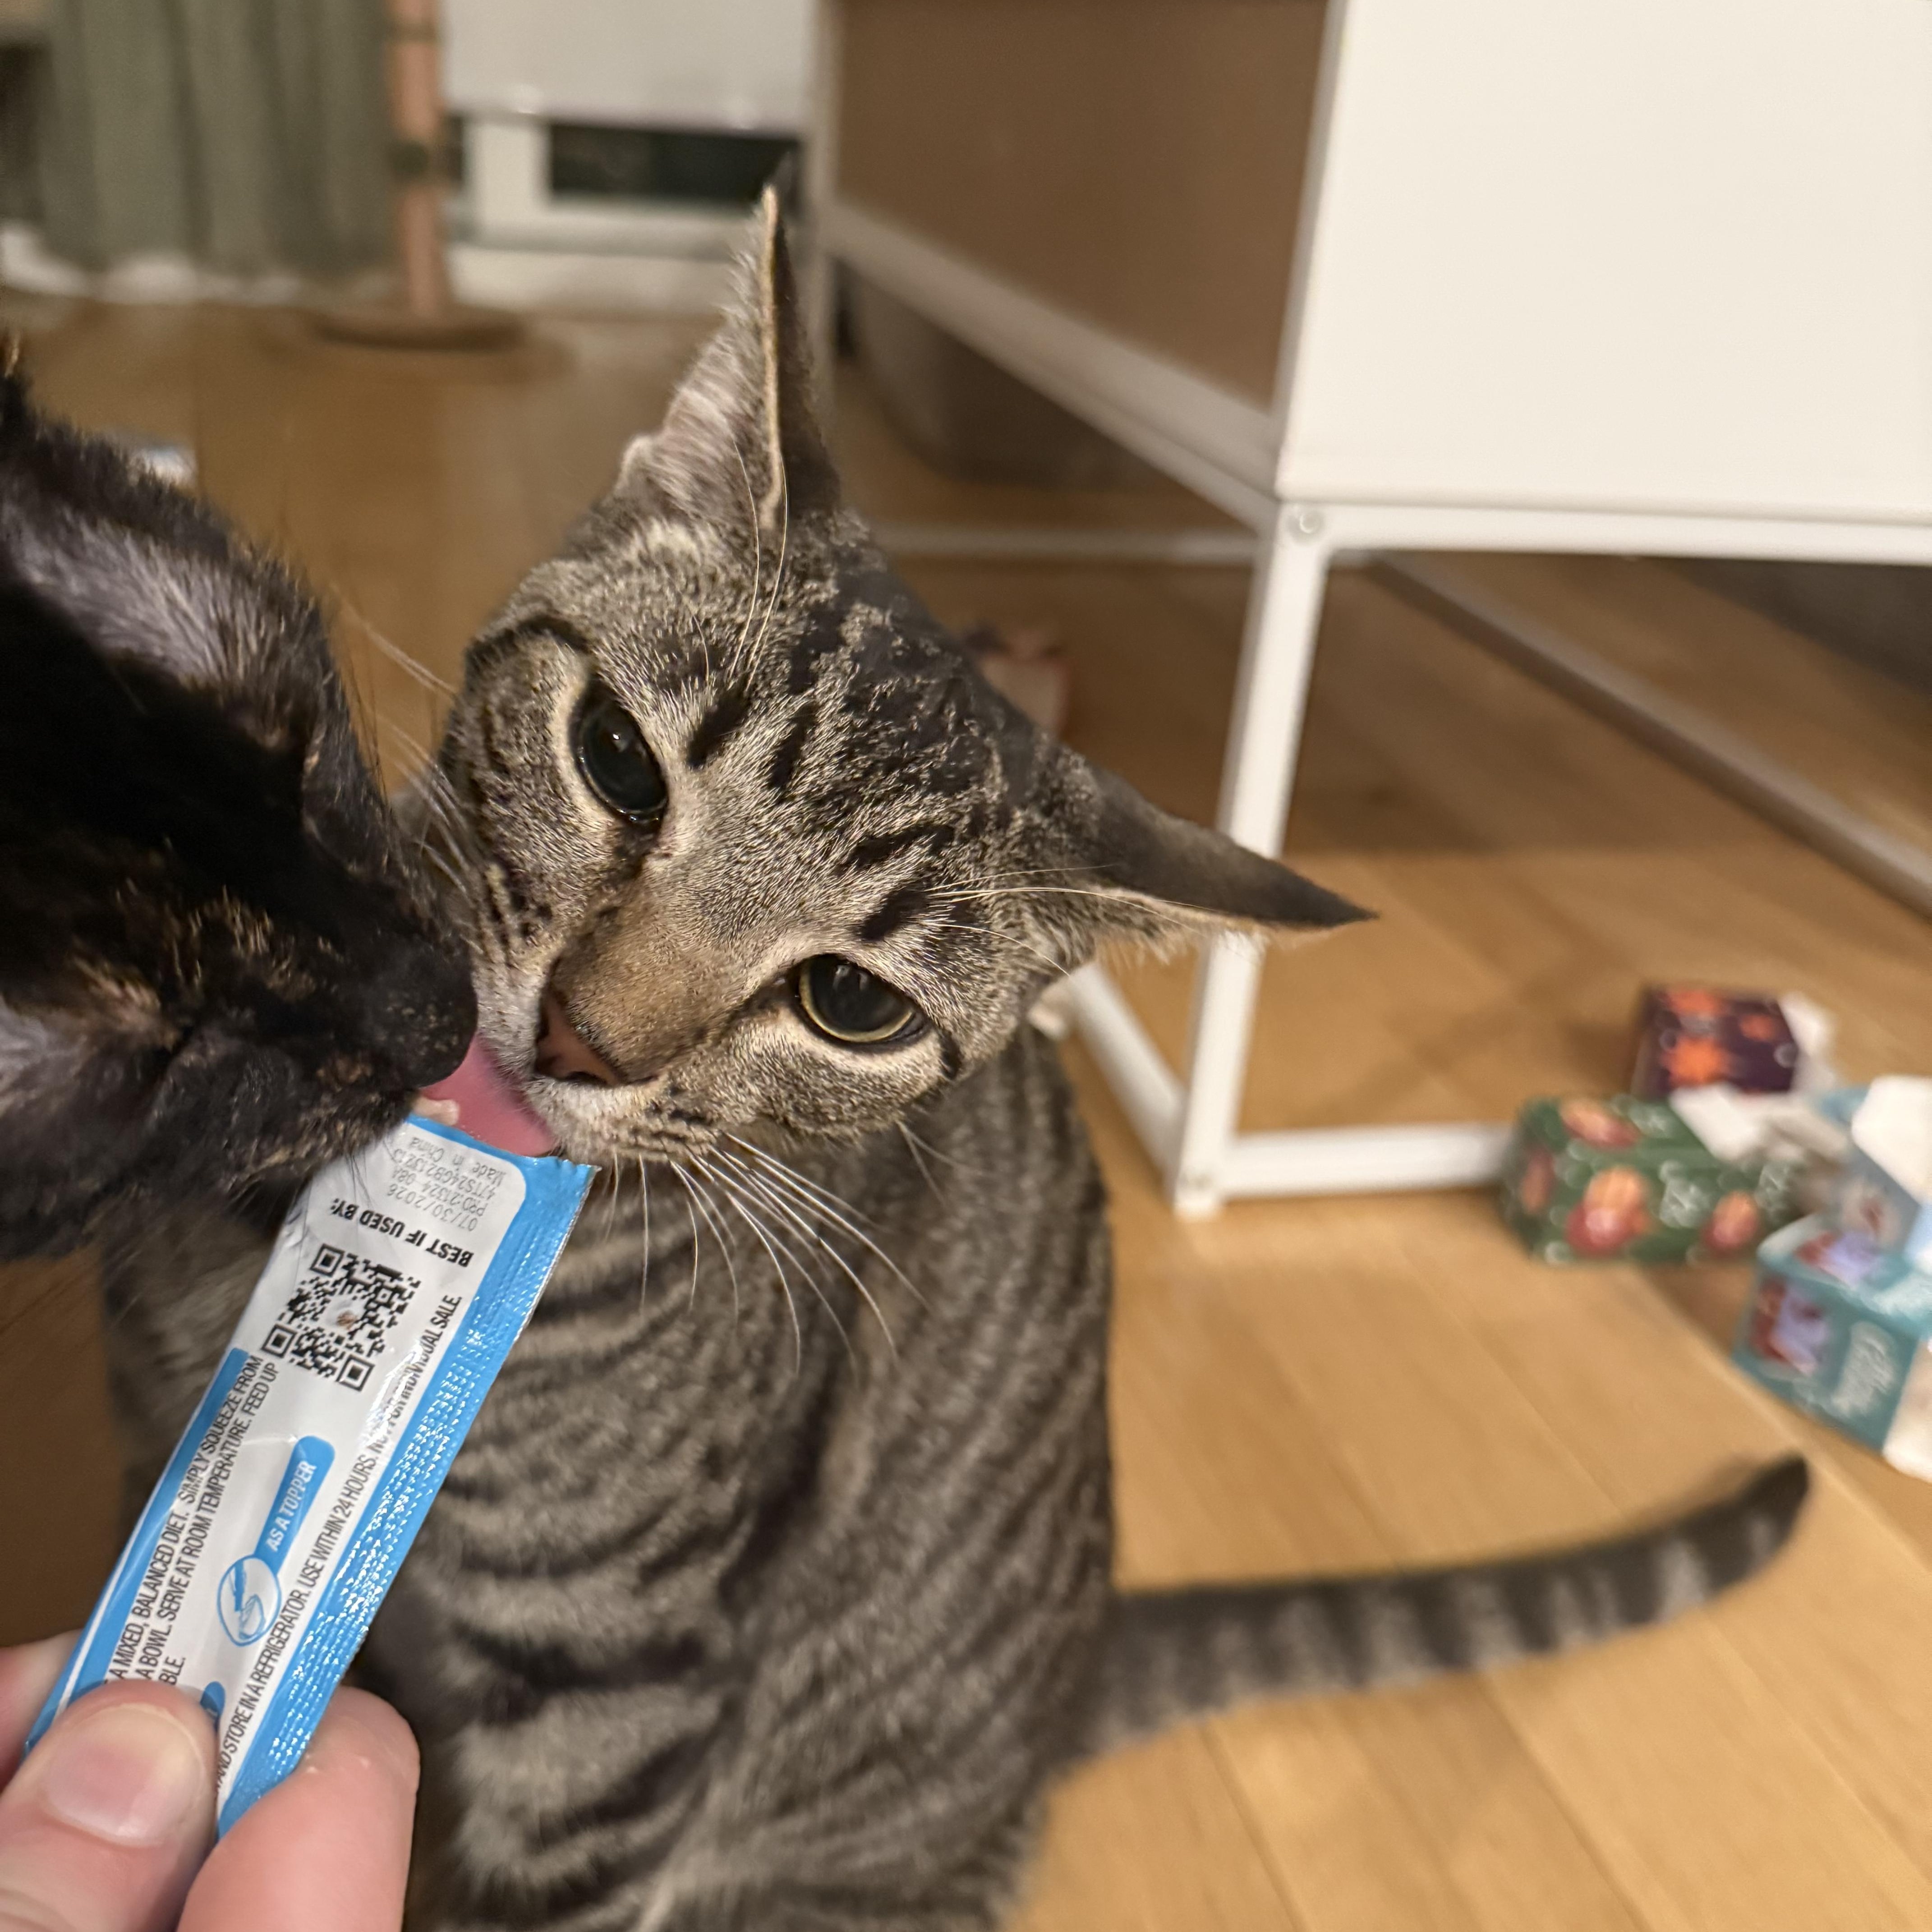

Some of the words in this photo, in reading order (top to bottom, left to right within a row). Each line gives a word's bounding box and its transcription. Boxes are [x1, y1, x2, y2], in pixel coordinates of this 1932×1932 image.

[410, 1136, 444, 1162] China
[452, 1155, 464, 1172] in
[472, 1162, 506, 1187] Made
[331, 1198, 359, 1220] BY:
[359, 1210, 405, 1237] USED
[387, 1184, 478, 1231] 07/30/2026
[405, 1230, 428, 1247] IF
[426, 1239, 474, 1268] BEST
[430, 1295, 462, 1329] SALE.
[234, 1356, 263, 1394] FROM
[260, 1362, 279, 1382] UP
[241, 1382, 269, 1416] FEED
[201, 1394, 242, 1454] SQUEEZE
[178, 1452, 210, 1504] SIMPLY
[196, 1418, 252, 1513] TEMPERATURE.
[341, 1455, 379, 1500] HOURS.
[279, 1460, 317, 1516] TOPPER
[275, 1517, 290, 1531] A
[332, 1498, 354, 1518] 24
[161, 1509, 189, 1544] DIET.
[181, 1514, 212, 1558] ROOM
[266, 1527, 284, 1551] AS
[310, 1514, 346, 1560] WITHIN
[132, 1544, 175, 1618] BALANCED
[175, 1557, 196, 1578] AT
[297, 1559, 325, 1588] USE
[157, 1576, 189, 1621] SERVE
[113, 1622, 150, 1667] MIXED,
[139, 1625, 172, 1667] BOWL.
[250, 1589, 311, 1685] REFRIGERATOR.
[109, 1669, 128, 1679] A
[135, 1669, 155, 1679] A
[247, 1682, 265, 1697] A
[239, 1693, 259, 1710] IN
[223, 1706, 253, 1753] STORE
